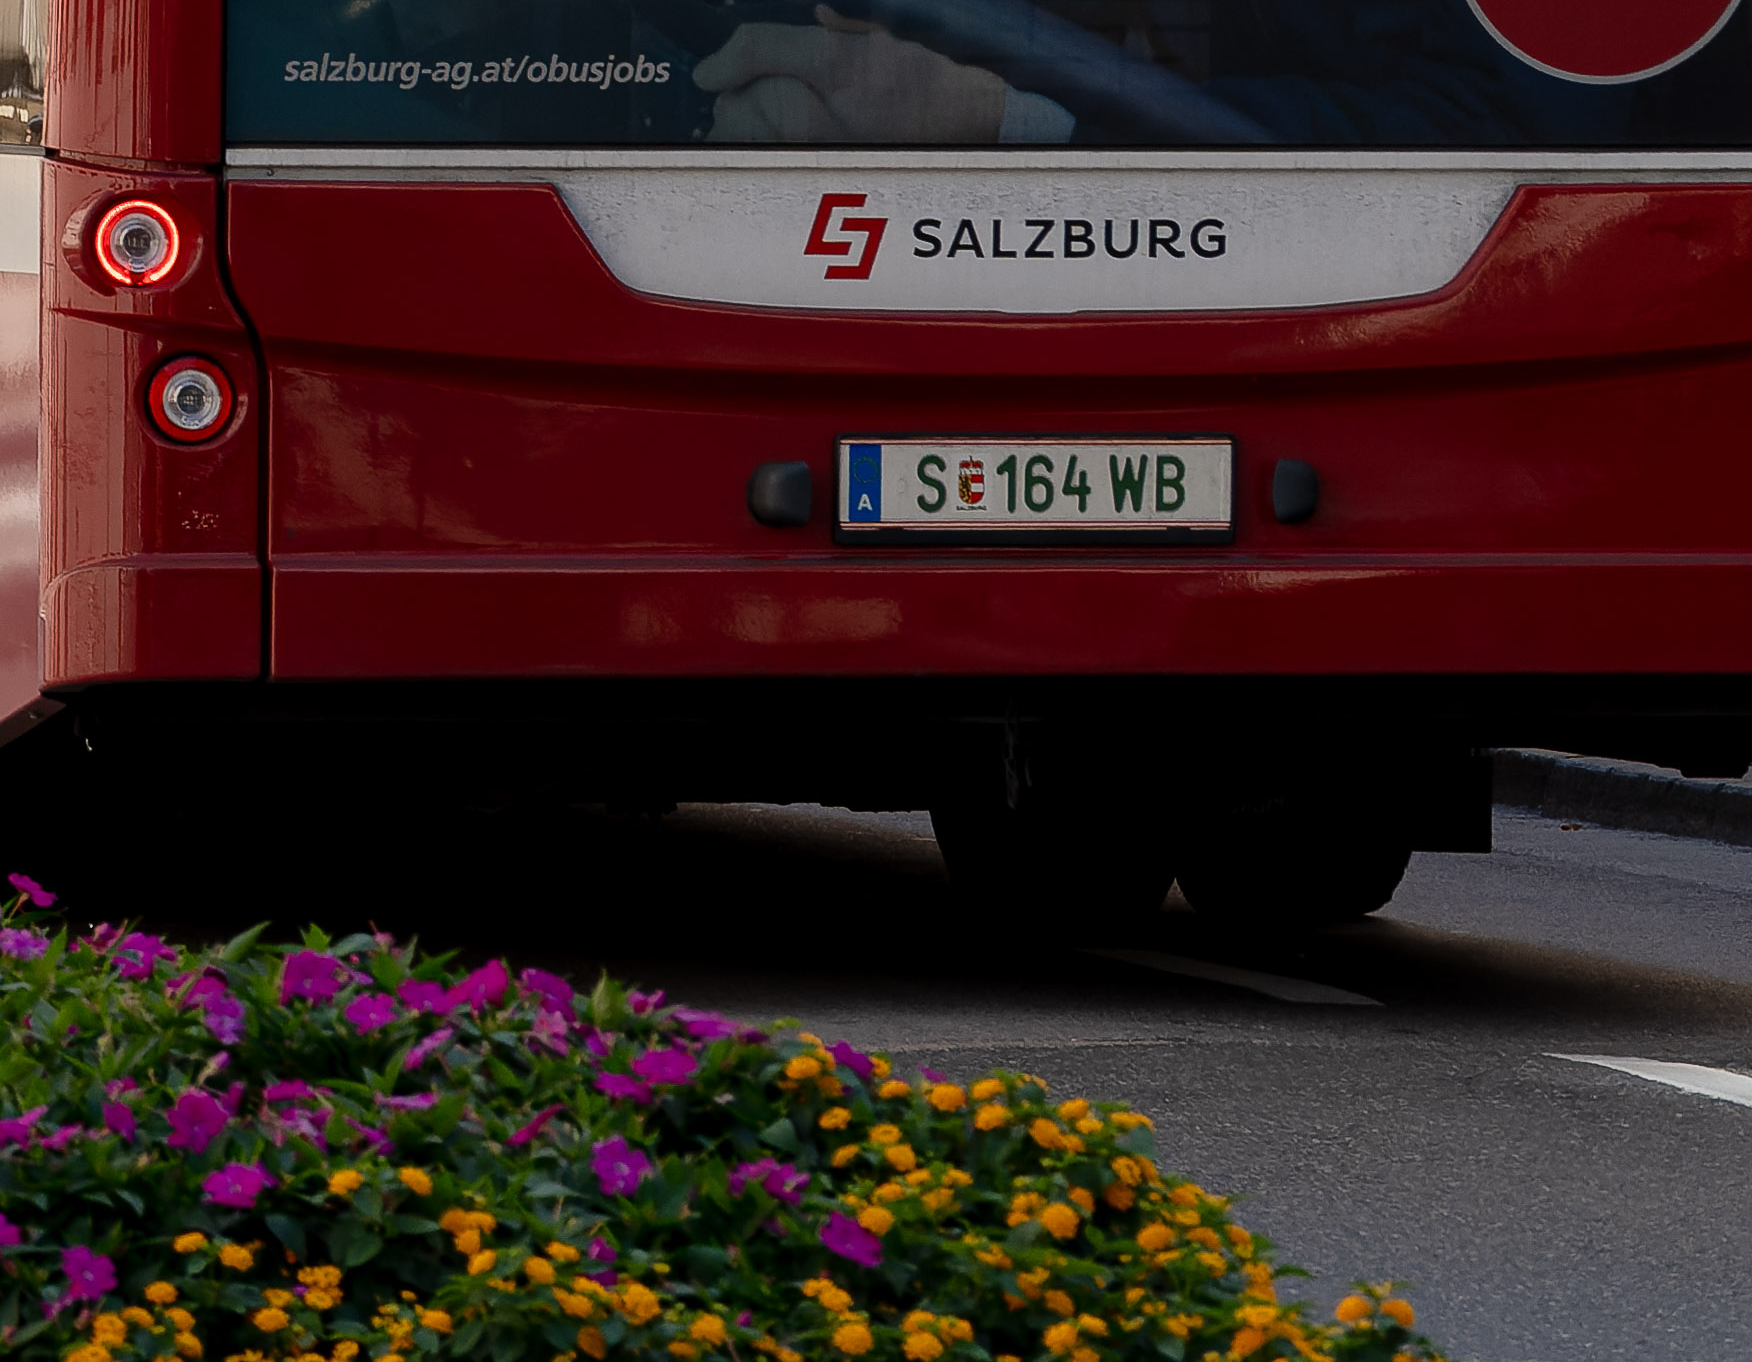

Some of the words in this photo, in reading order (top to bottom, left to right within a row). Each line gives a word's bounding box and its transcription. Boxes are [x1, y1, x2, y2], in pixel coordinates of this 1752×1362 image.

[284, 52, 671, 91] salzburg-ag.at/obusjobs
[912, 218, 1227, 259] SALZBURG
[916, 454, 947, 513] S
[996, 454, 1092, 514] 164
[1108, 454, 1186, 513] WB
